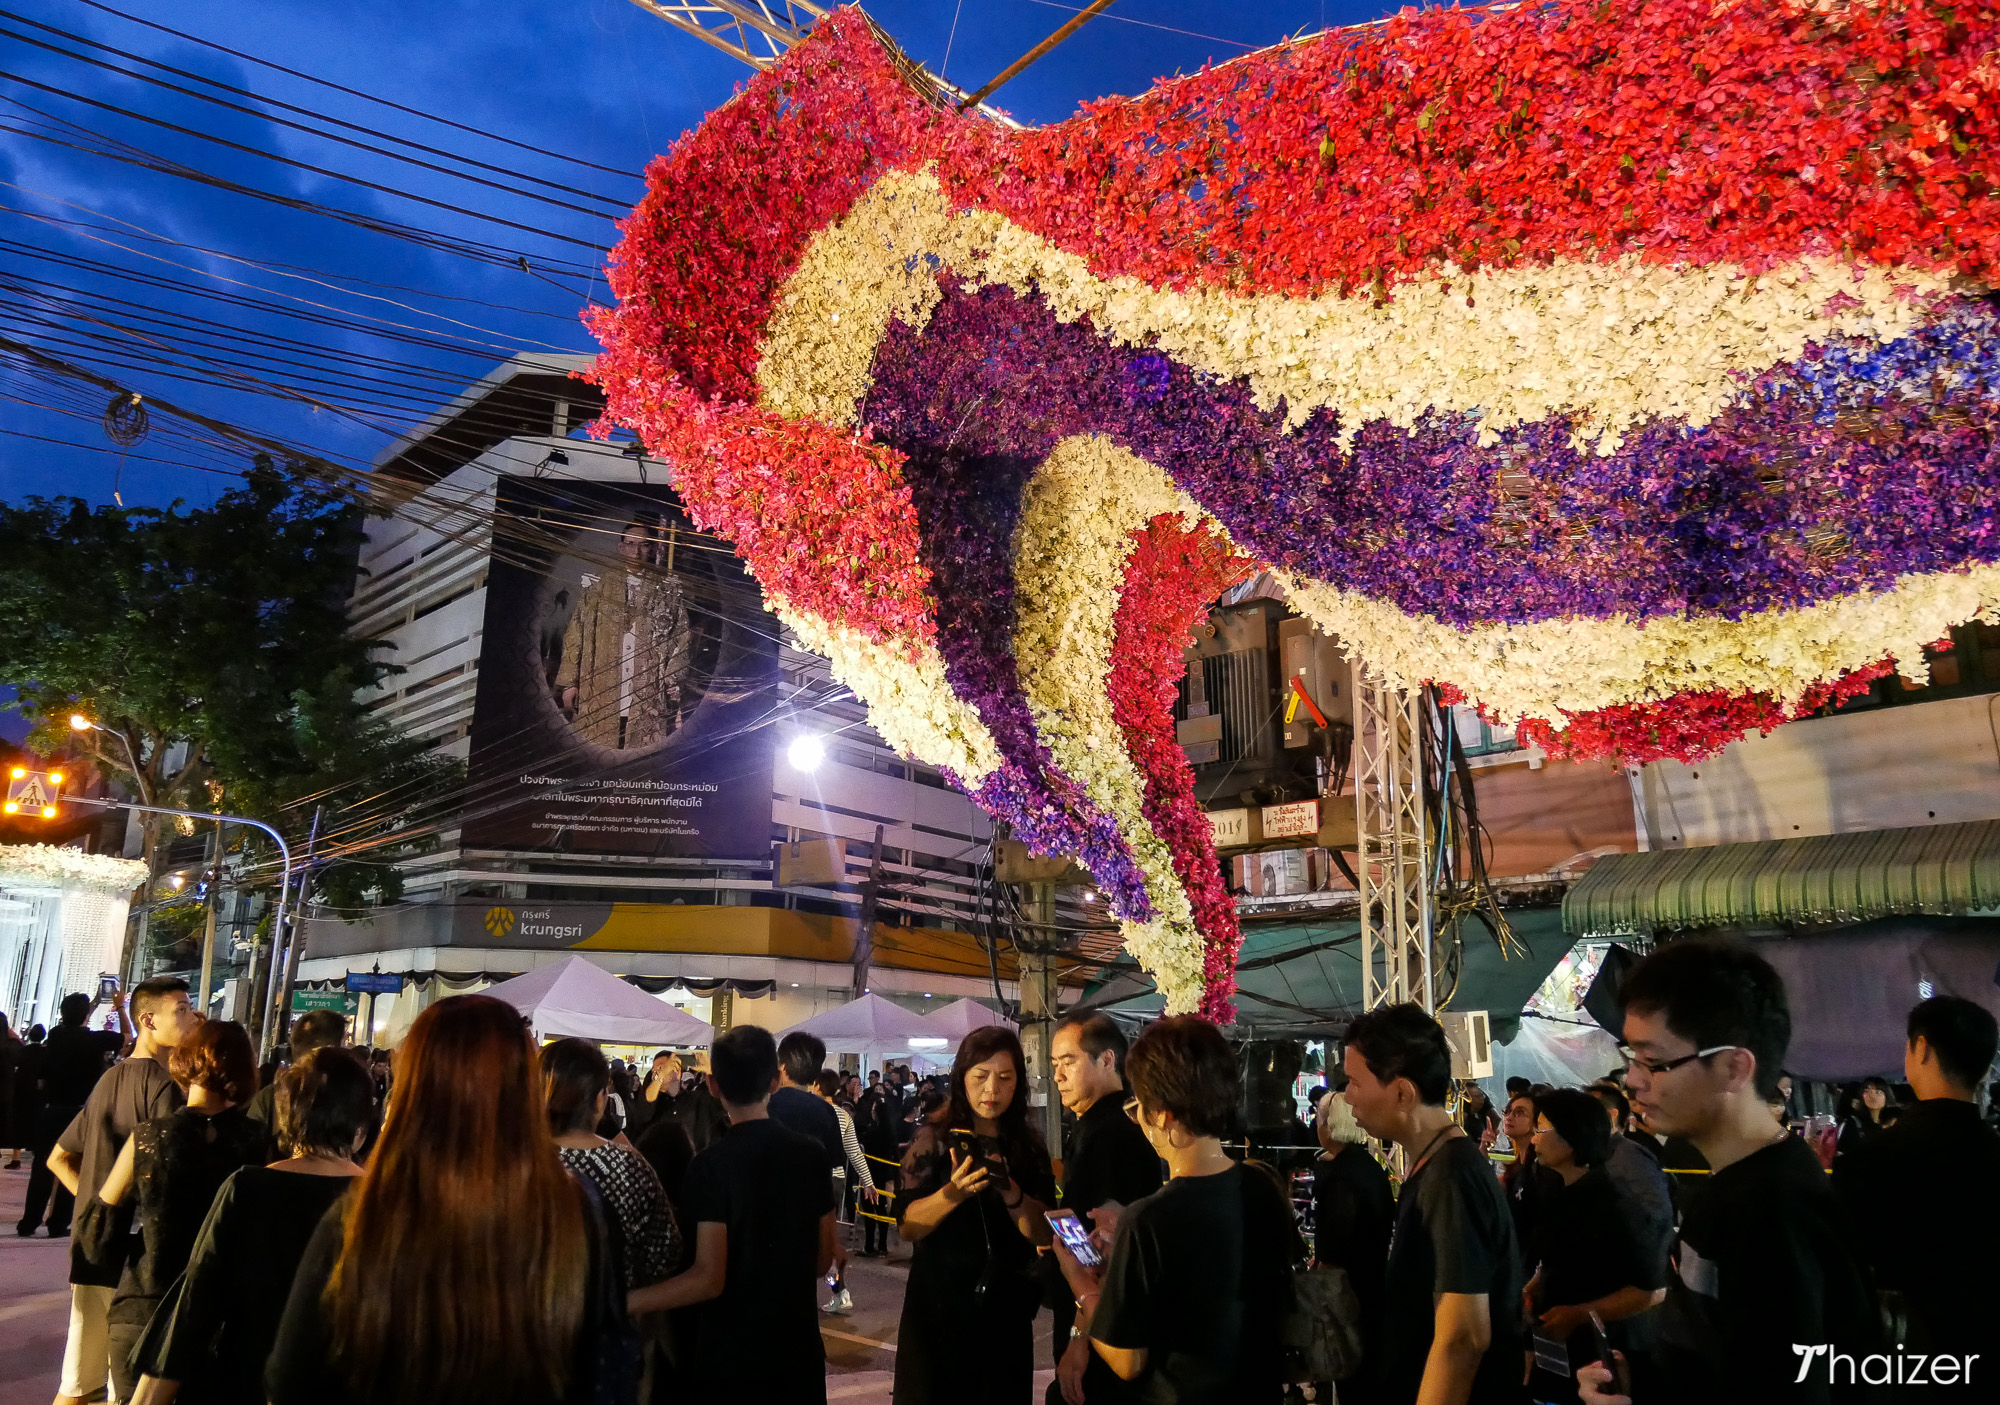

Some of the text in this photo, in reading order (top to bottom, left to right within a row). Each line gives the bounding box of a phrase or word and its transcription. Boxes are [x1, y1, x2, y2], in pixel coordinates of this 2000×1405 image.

[521, 908, 551, 921] กรุงศรี
[520, 922, 582, 939] krungsri
